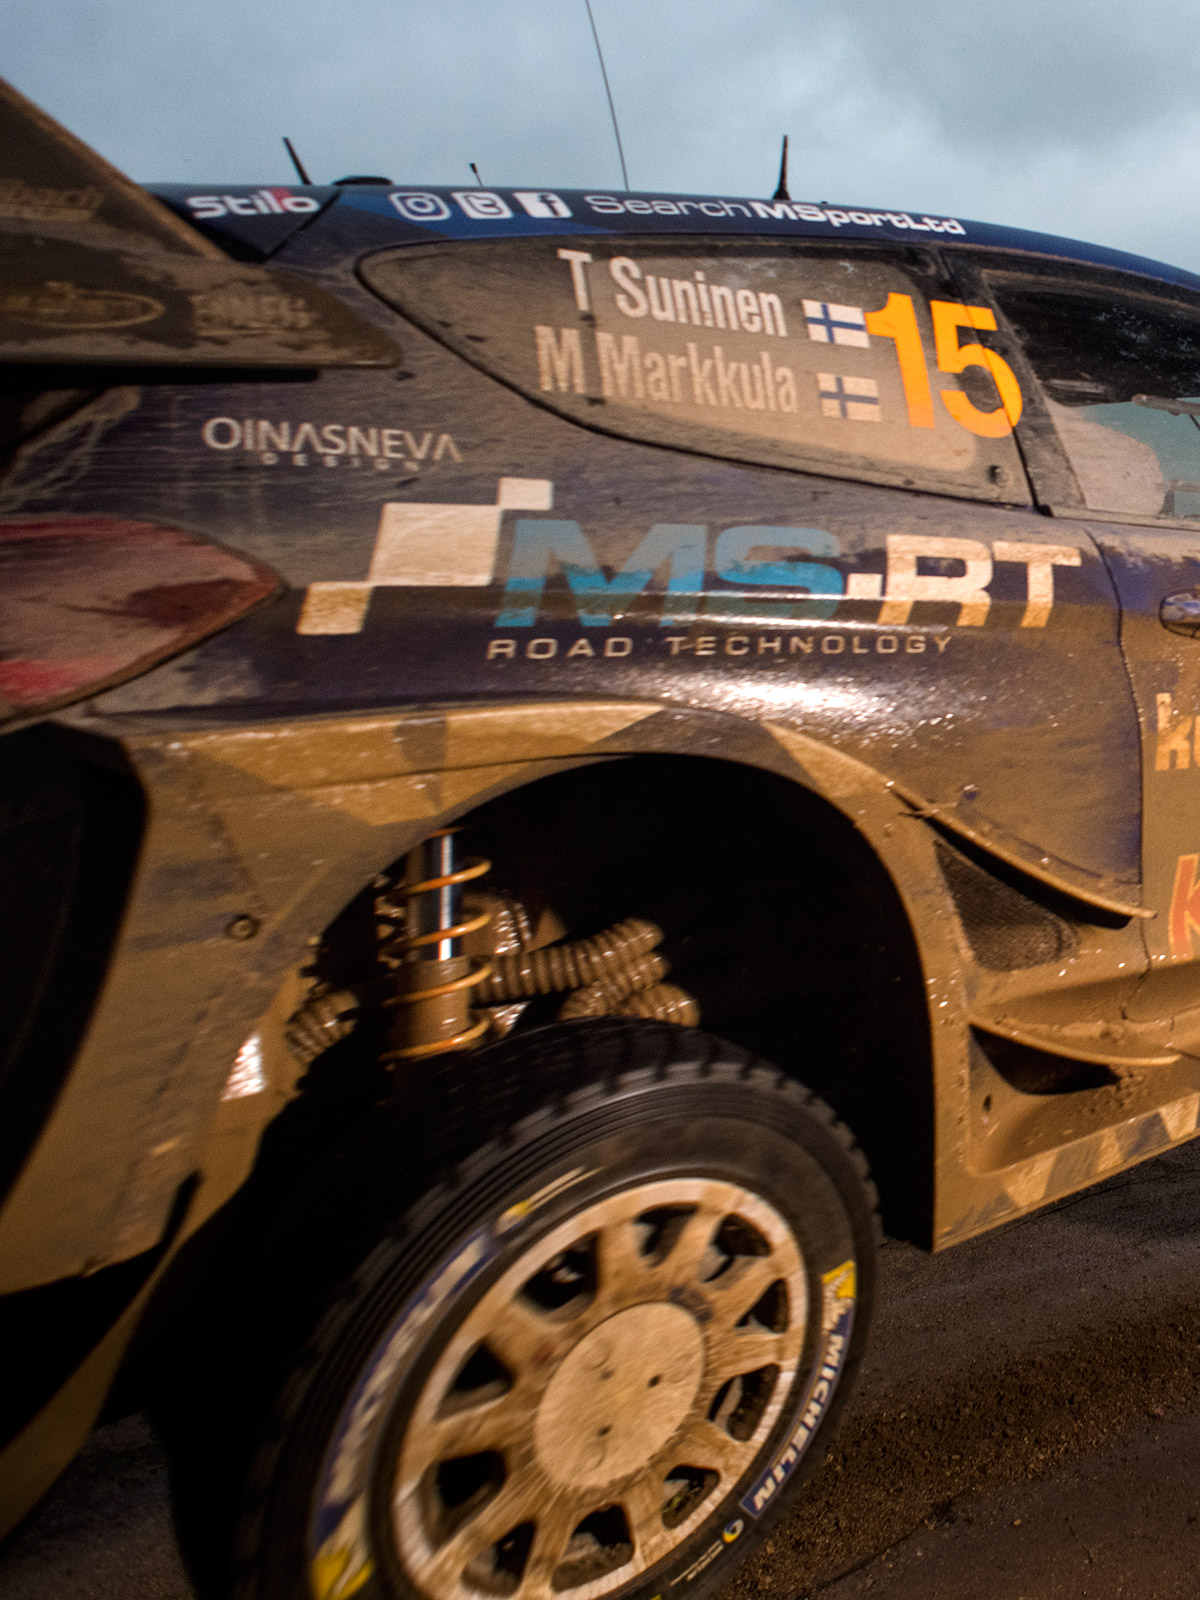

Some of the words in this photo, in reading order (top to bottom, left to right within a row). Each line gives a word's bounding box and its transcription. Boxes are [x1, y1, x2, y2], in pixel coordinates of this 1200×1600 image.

[185, 188, 322, 219] Stilo
[557, 248, 593, 312] T
[608, 256, 788, 337] Suninen
[534, 324, 586, 396] M
[596, 330, 799, 414] Markkula
[865, 292, 1024, 438] 15
[202, 416, 464, 463] OINASNEVA
[485, 636, 634, 661] ROAD
[665, 634, 952, 657] TECHNOLOGY
[753, 1333, 845, 1512] MICHELIN
